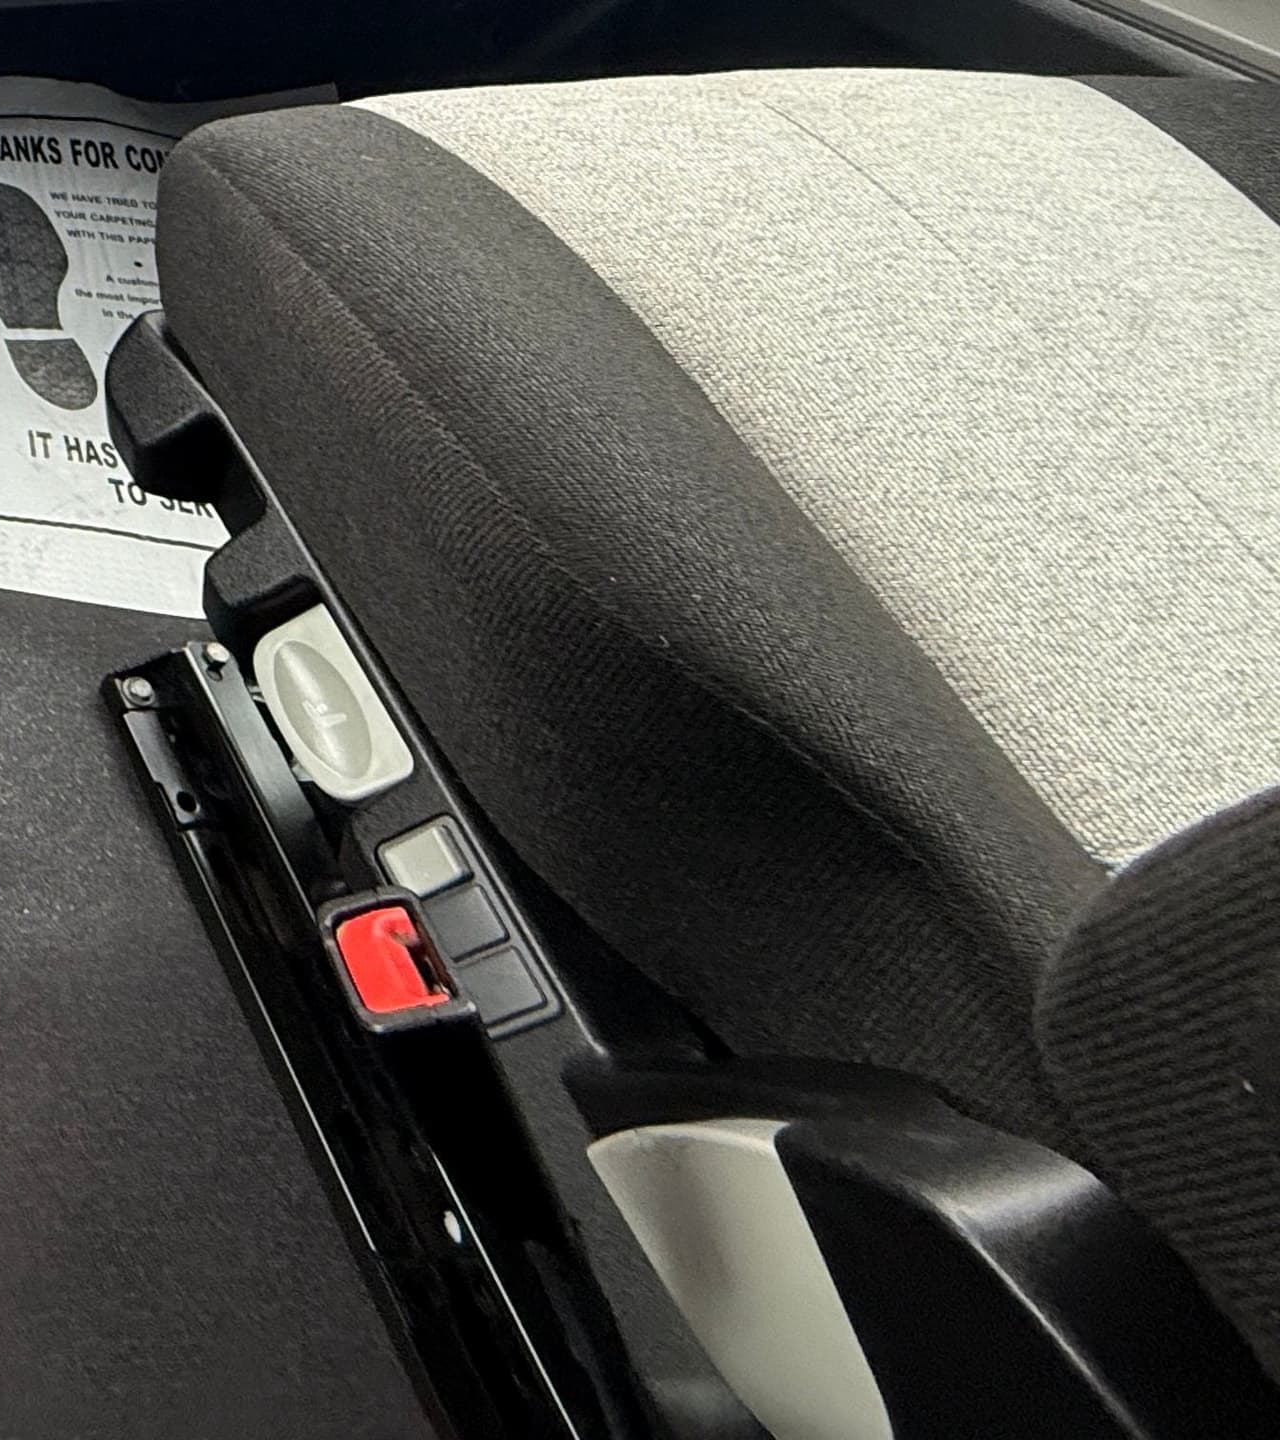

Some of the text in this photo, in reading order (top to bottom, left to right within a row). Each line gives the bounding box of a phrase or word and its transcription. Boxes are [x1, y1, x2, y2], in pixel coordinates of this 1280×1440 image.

[69, 138, 120, 170] FOR
[50, 191, 69, 202] WE
[72, 192, 104, 205] HAVE
[106, 196, 140, 209] TRIED
[54, 210, 87, 221] YOUR
[66, 228, 96, 240] WITH
[98, 231, 126, 243] THIS
[28, 429, 119, 469] IT HAS
[107, 477, 148, 507] TO
